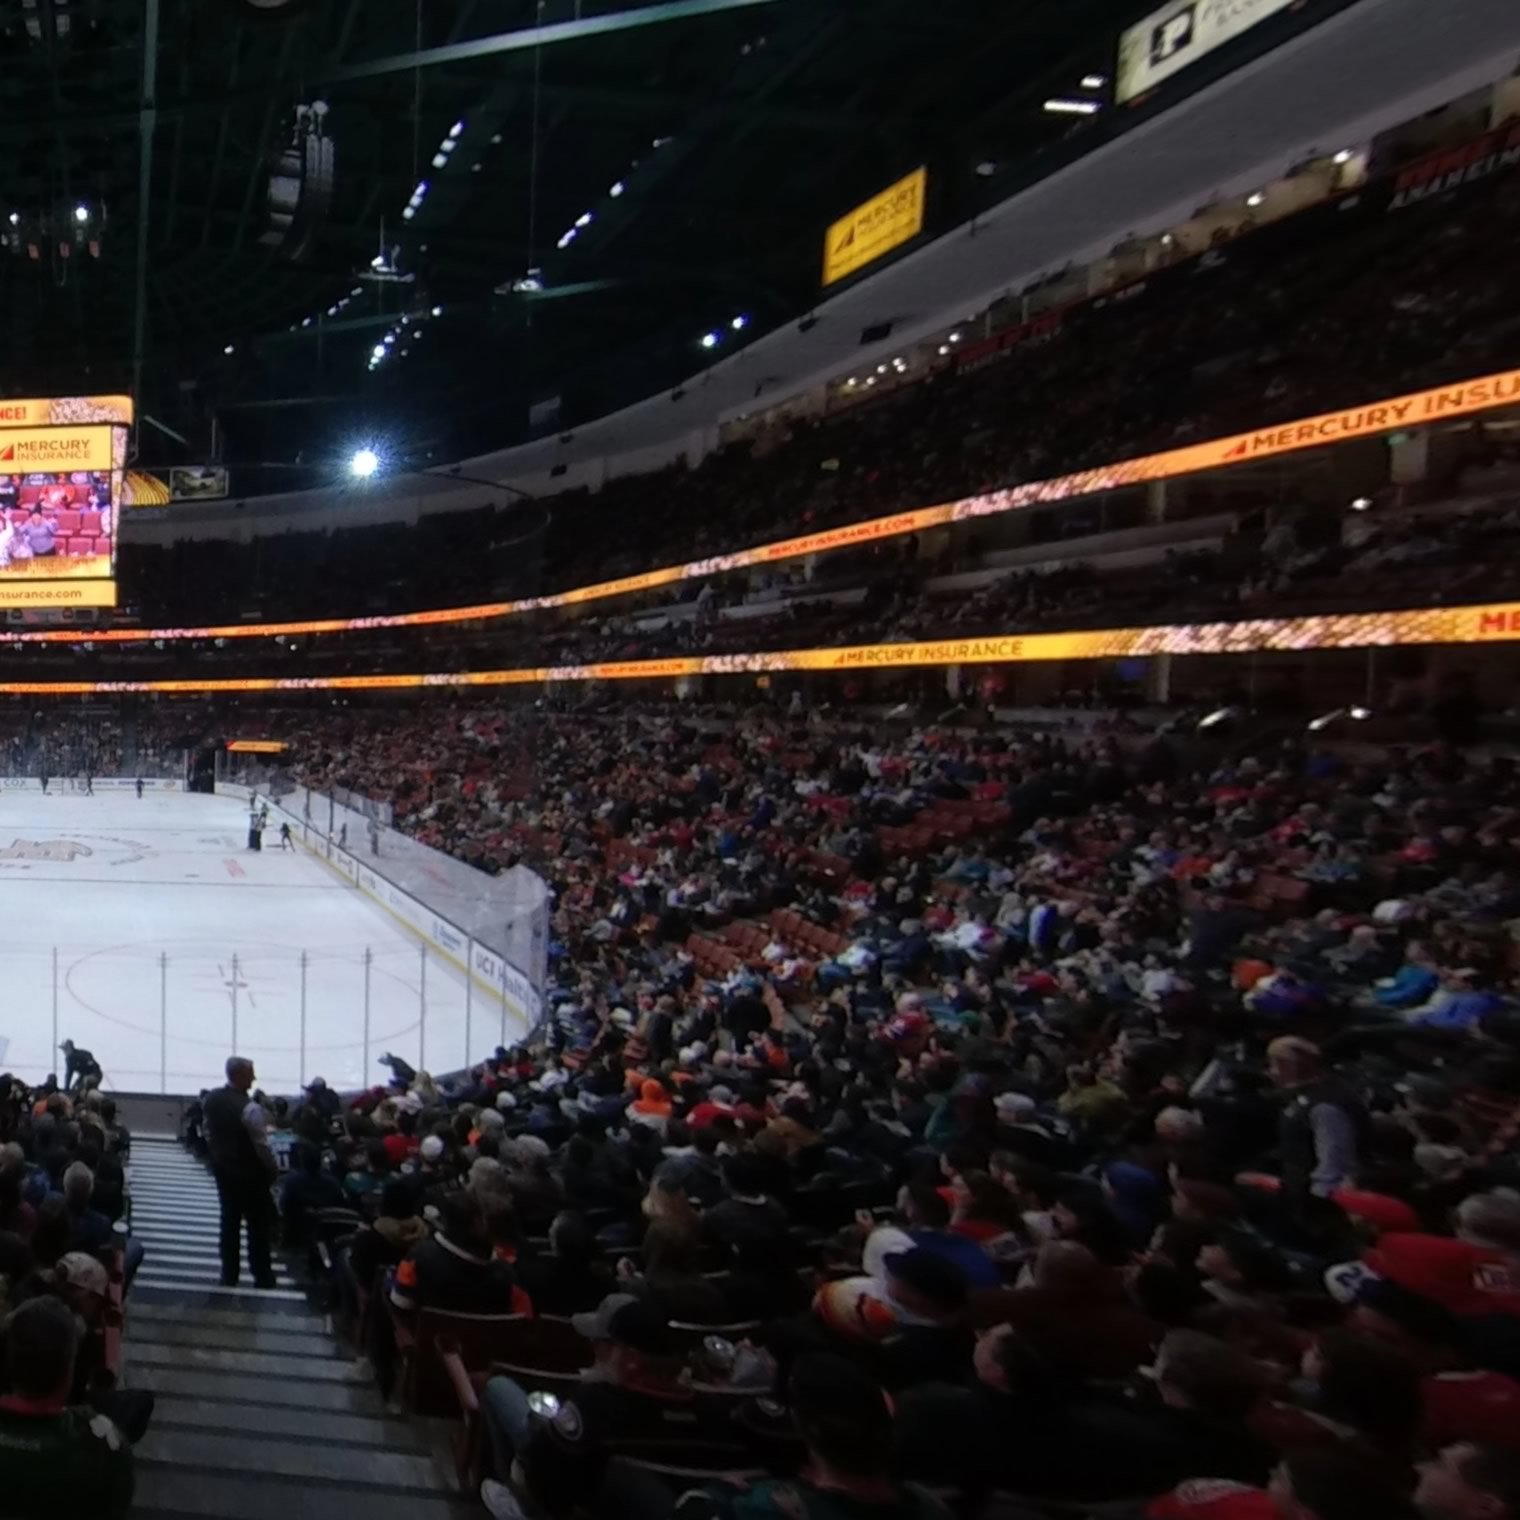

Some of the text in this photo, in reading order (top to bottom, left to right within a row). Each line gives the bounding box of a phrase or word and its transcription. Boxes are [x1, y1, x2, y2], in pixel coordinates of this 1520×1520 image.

[1253, 400, 1413, 450] MERCURY
[17, 439, 91, 451] MERCURY
[16, 450, 91, 461] INSURANCE
[846, 641, 1024, 664] MERCURY INSURANCE
